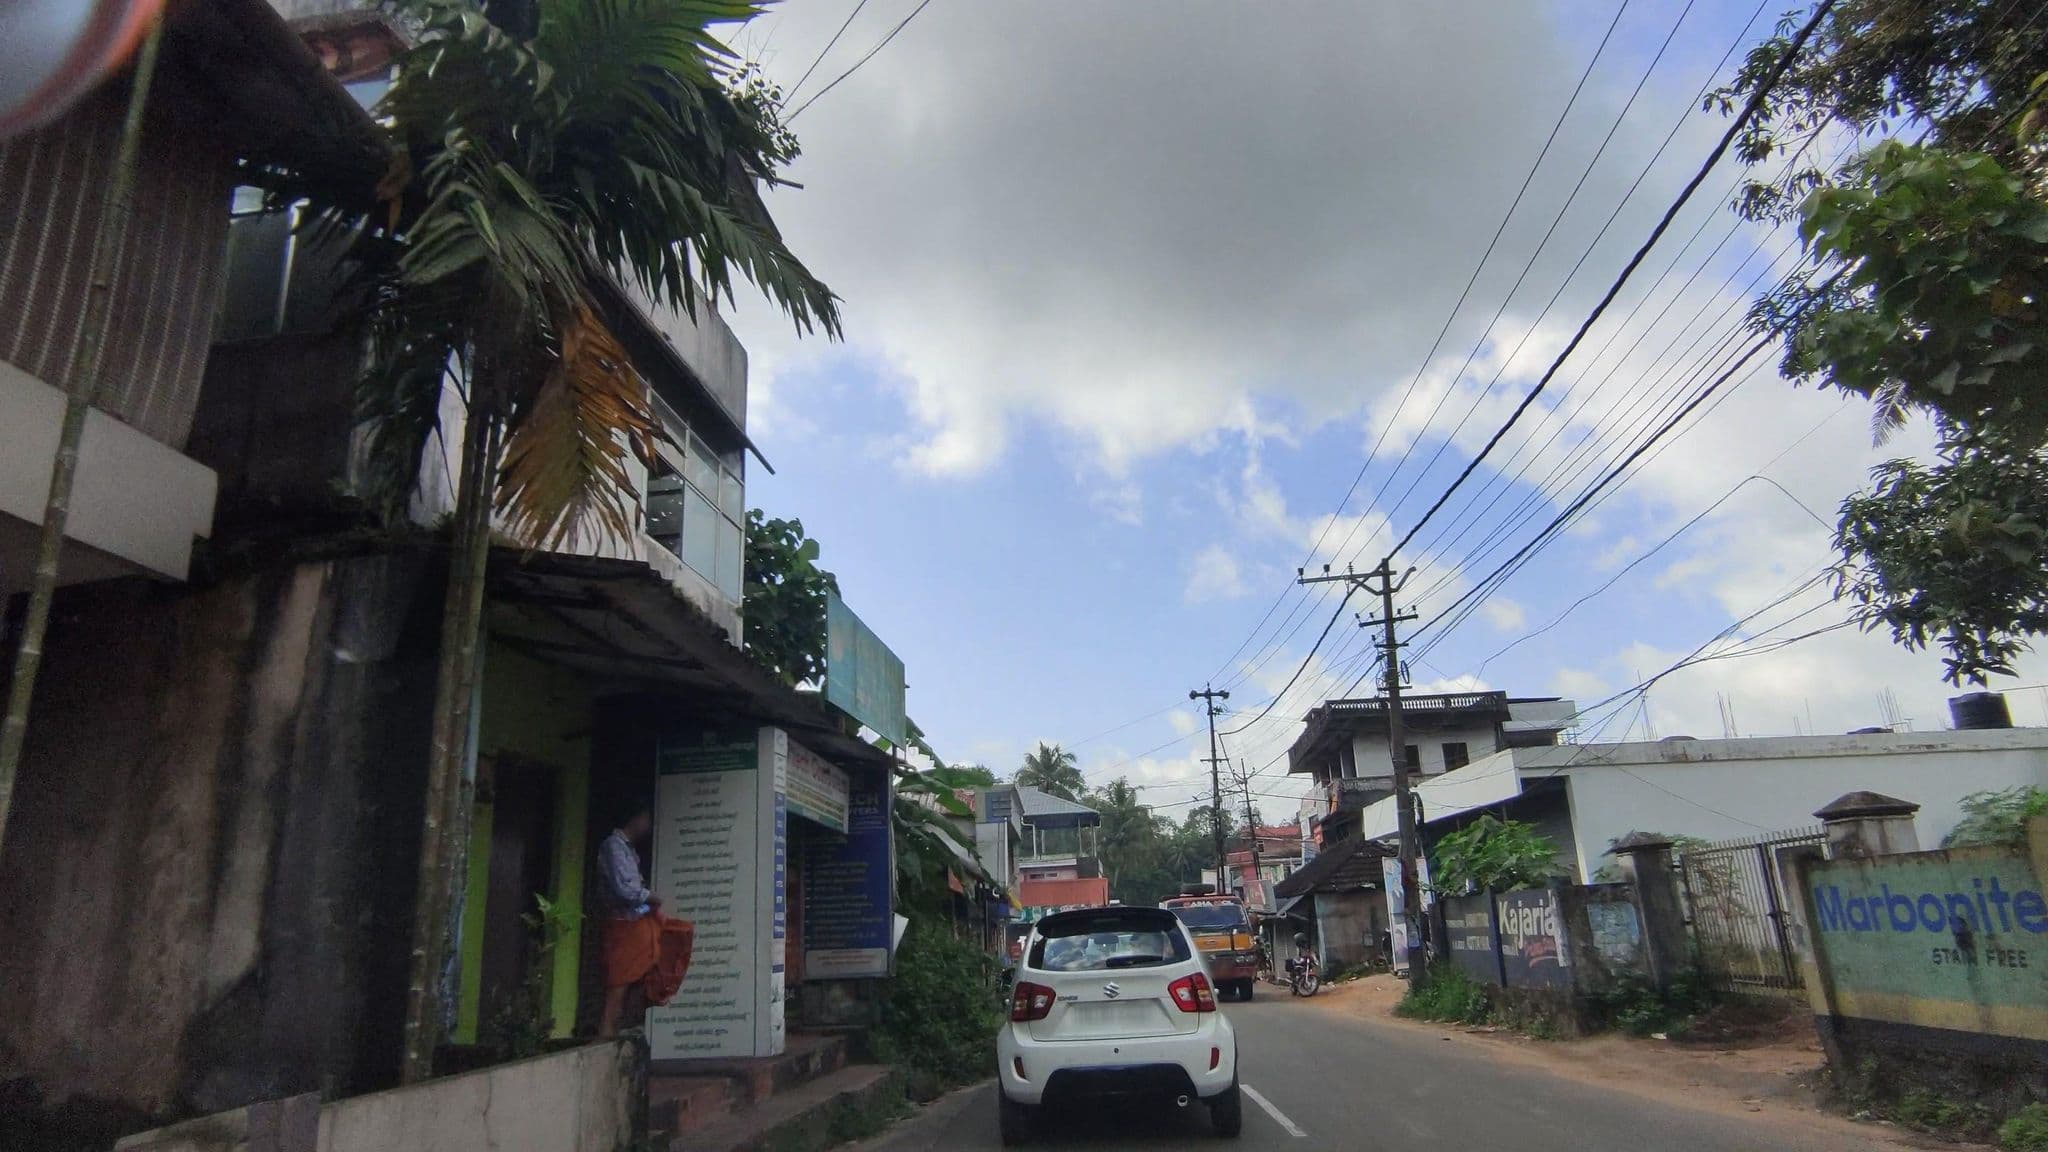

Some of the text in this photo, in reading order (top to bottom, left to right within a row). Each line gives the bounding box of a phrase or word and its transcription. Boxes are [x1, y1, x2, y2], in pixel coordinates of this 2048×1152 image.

[1498, 898, 1556, 950] Kajaria
[1814, 876, 2048, 935] Marbonite
[1986, 948, 2029, 969] FREE
